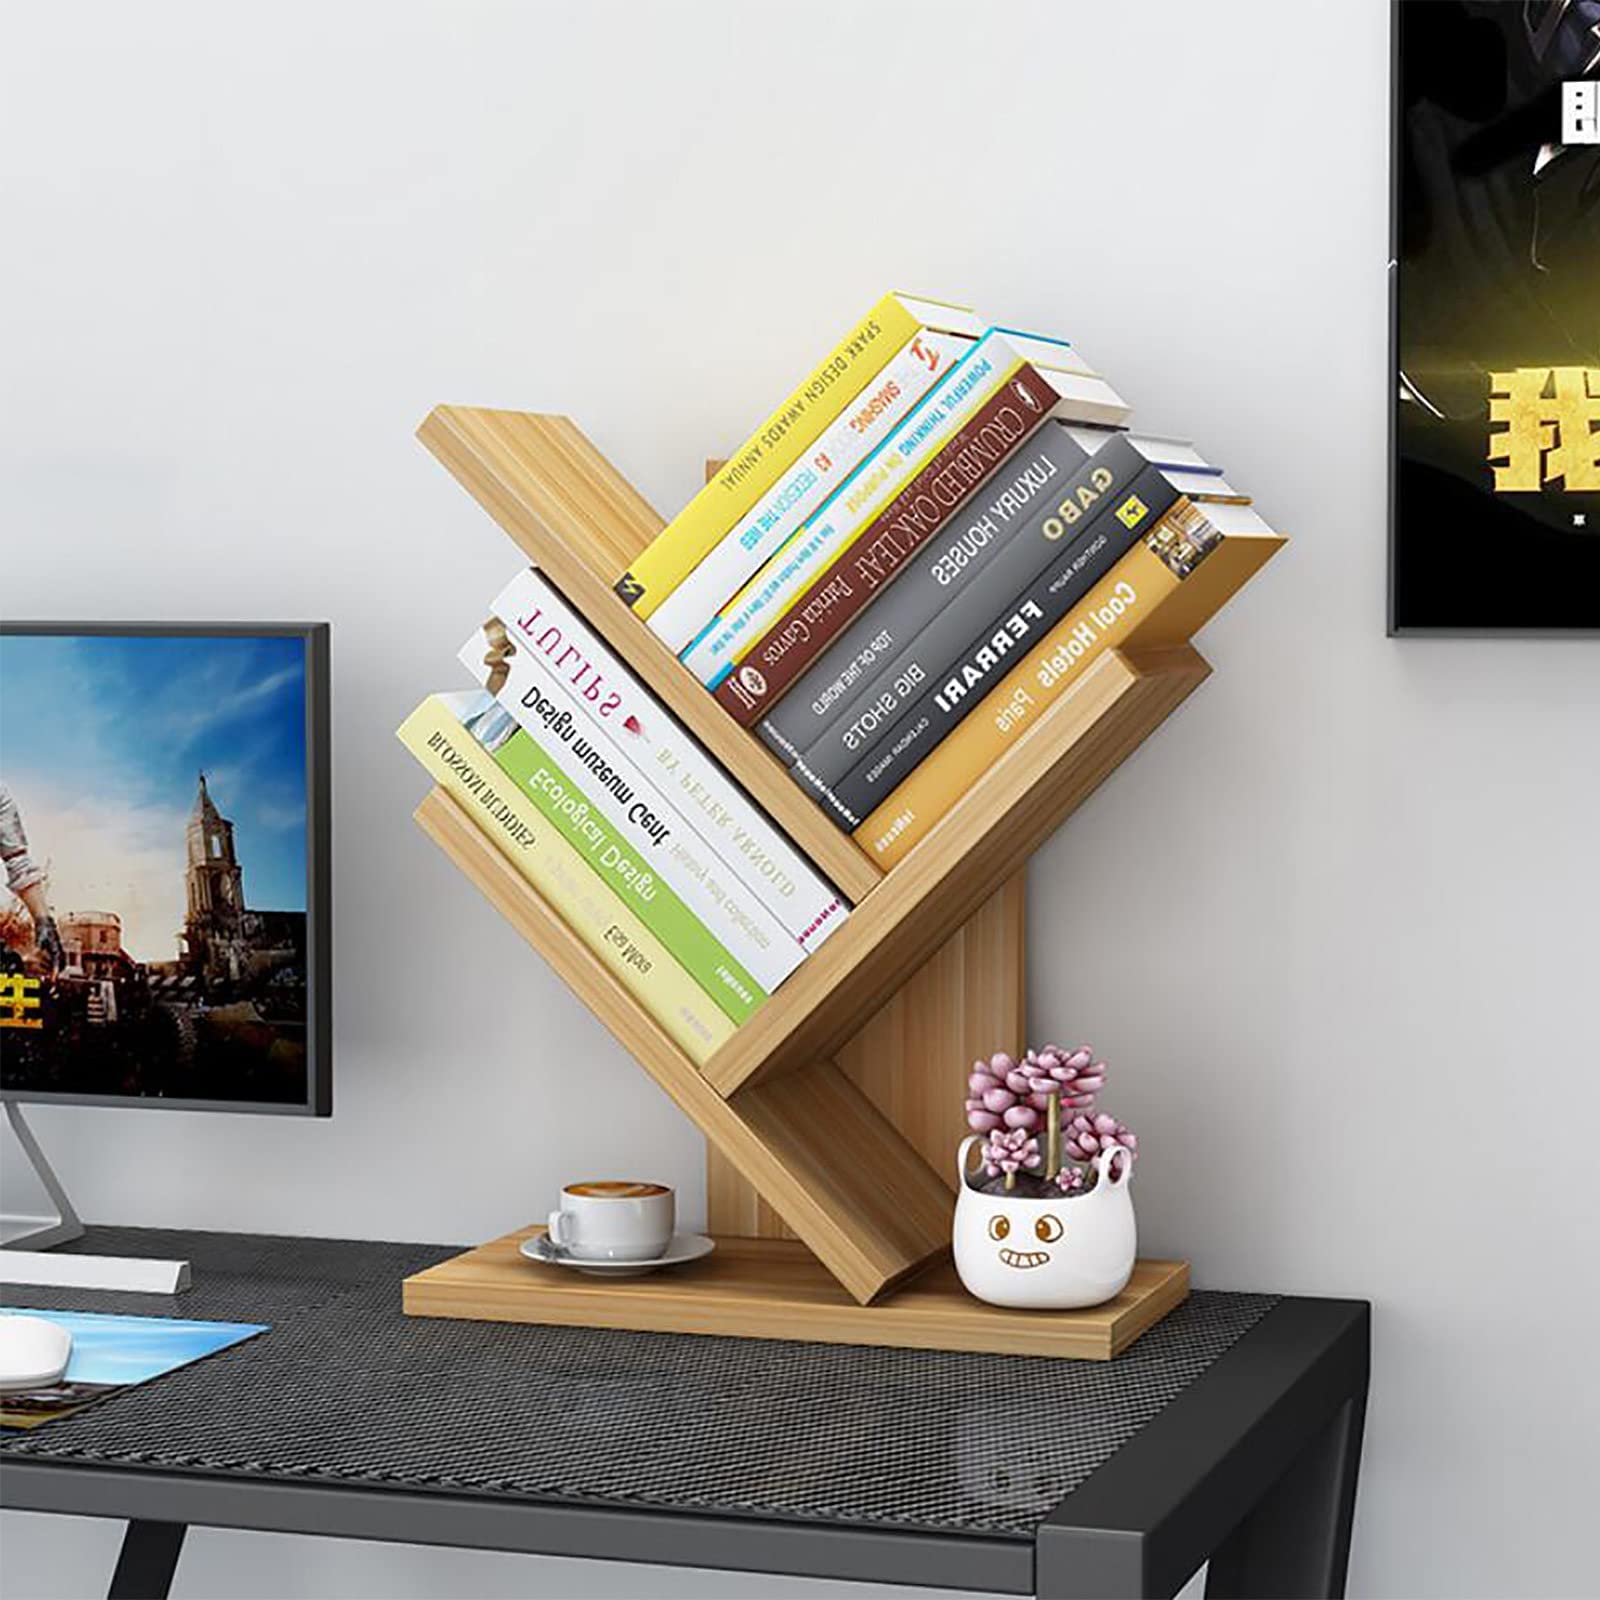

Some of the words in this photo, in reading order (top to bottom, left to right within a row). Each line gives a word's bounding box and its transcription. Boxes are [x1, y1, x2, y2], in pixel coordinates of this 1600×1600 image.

[843, 320, 882, 360] SPARK
[802, 355, 848, 403] DESIGN
[940, 357, 993, 412] POWERFUL
[759, 398, 808, 449] AWARDS
[848, 379, 902, 435] SMASHING
[897, 407, 946, 457] THINKING
[719, 444, 765, 492] ANNUAL
[926, 403, 1027, 508] CRUMBLED
[889, 491, 943, 547] OAK
[849, 529, 907, 589] LEAF
[800, 574, 853, 629] Patricia
